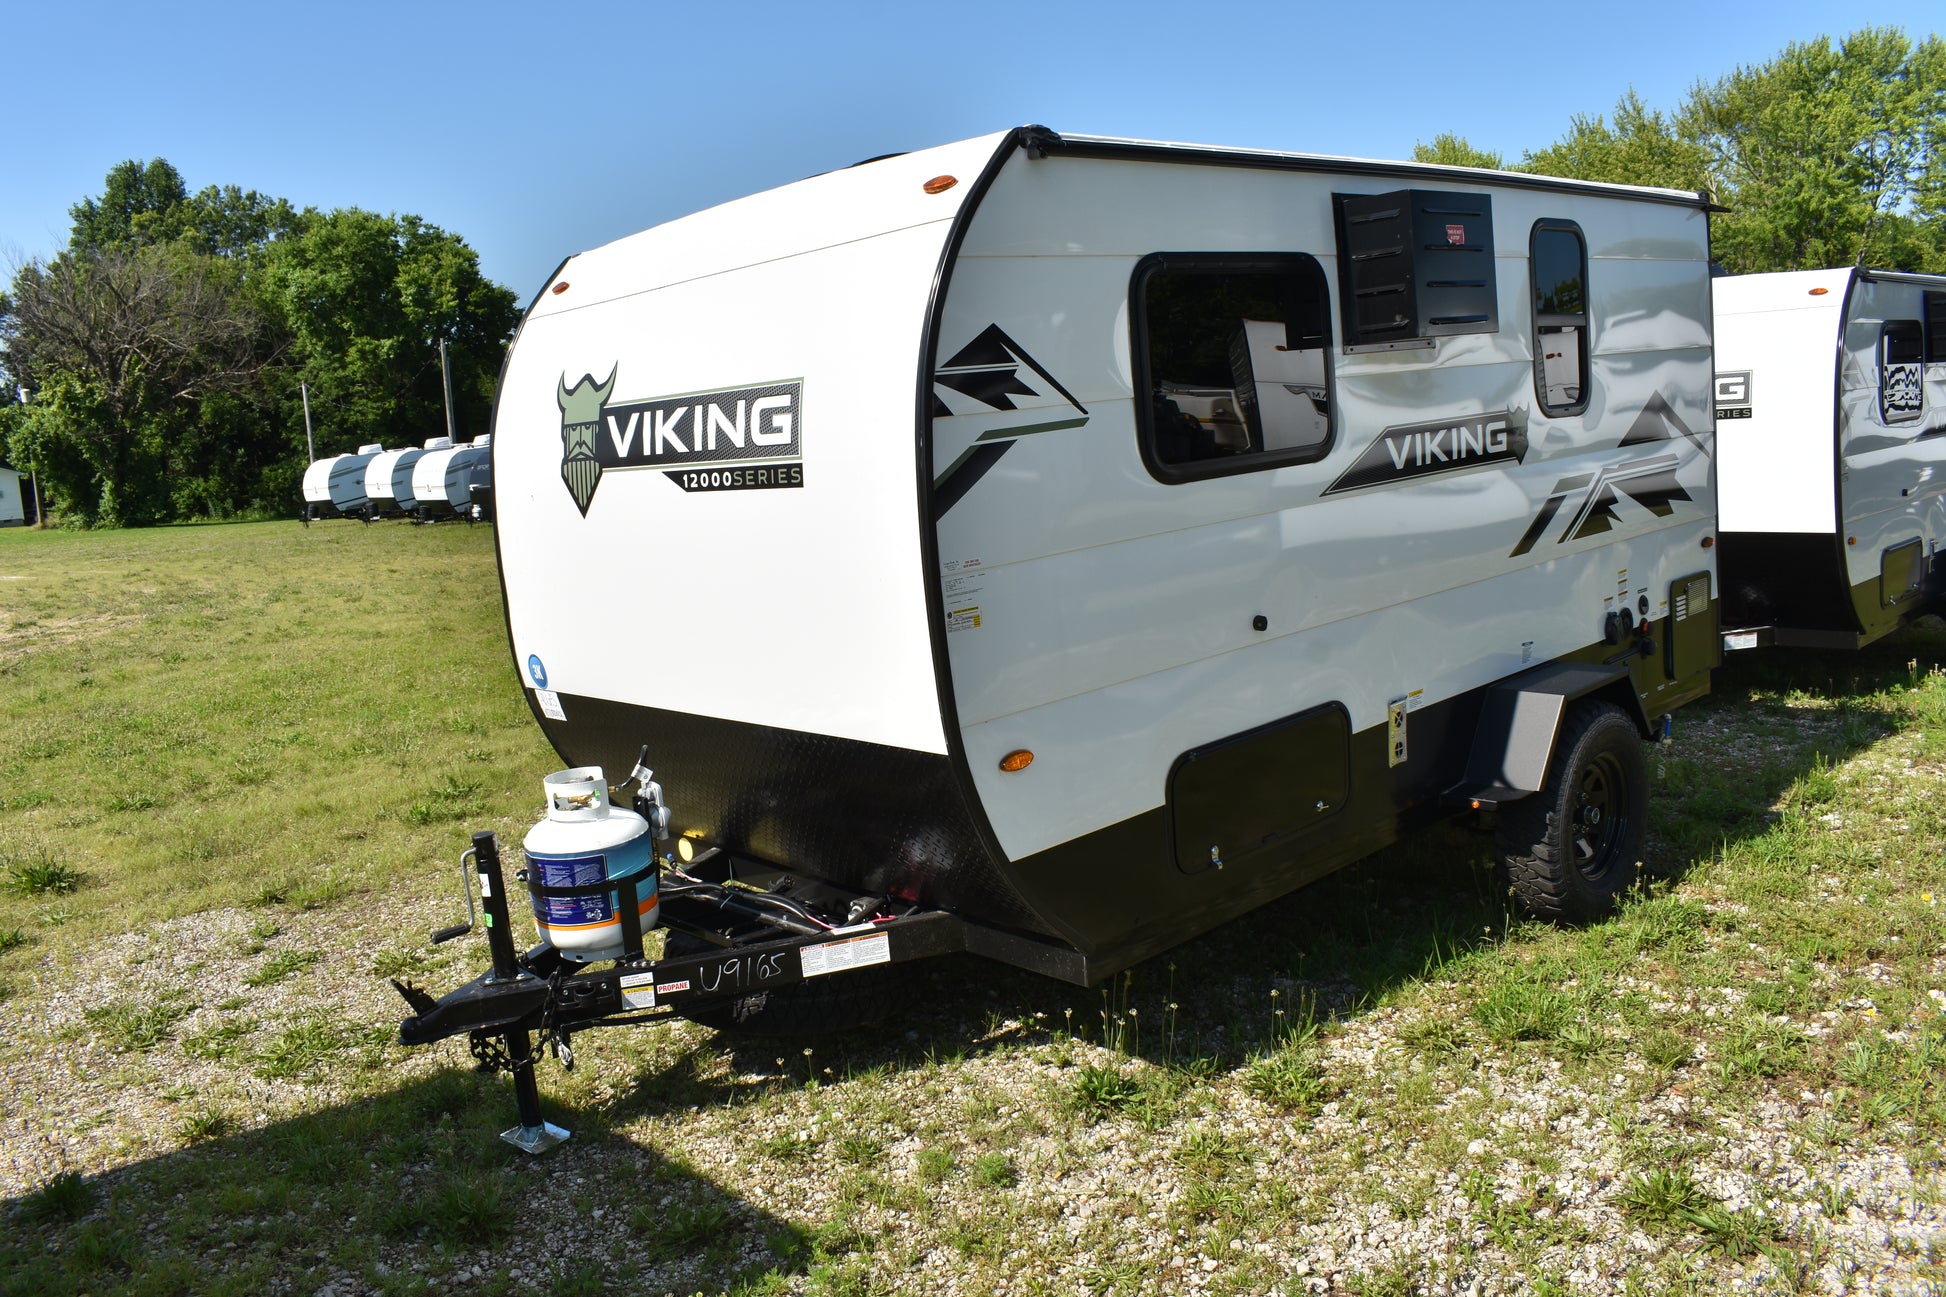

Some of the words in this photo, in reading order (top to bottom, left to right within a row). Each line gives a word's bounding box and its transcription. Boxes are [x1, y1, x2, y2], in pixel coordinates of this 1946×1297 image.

[607, 394, 793, 458] VIKING
[1384, 420, 1508, 470] VIKING
[658, 981, 689, 993] PROPANE
[700, 952, 786, 992] U9165
